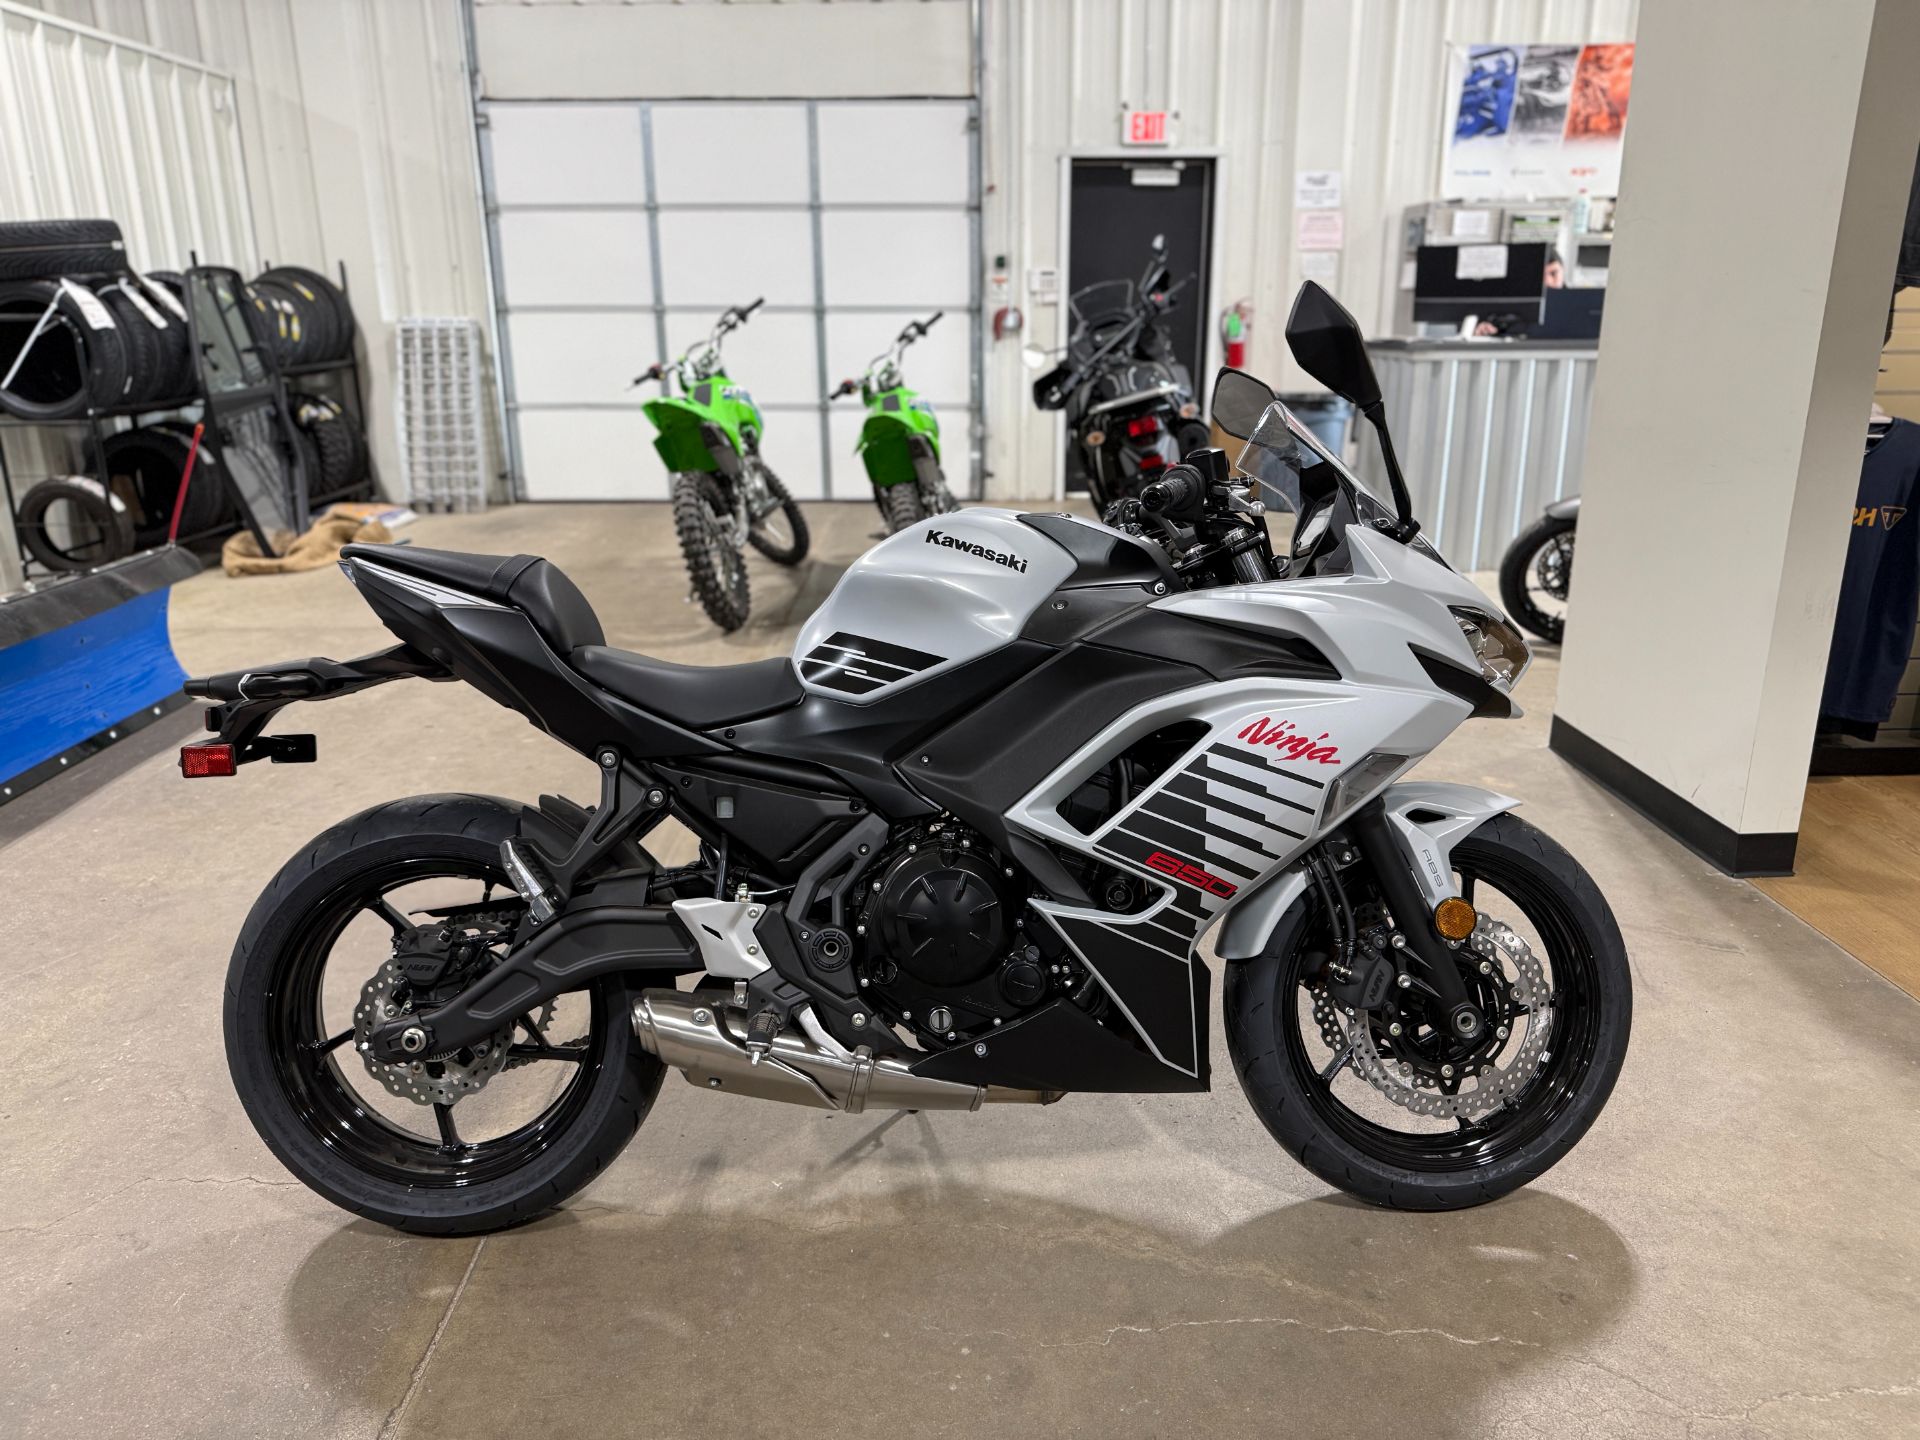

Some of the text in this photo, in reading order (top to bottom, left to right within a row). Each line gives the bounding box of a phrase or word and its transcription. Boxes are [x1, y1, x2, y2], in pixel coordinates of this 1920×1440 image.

[1132, 112, 1166, 142] EXIT
[925, 529, 1028, 574] Kawasaki
[1237, 716, 1340, 764] Ninja
[1144, 851, 1239, 898] 650
[1422, 849, 1443, 887] ABS
